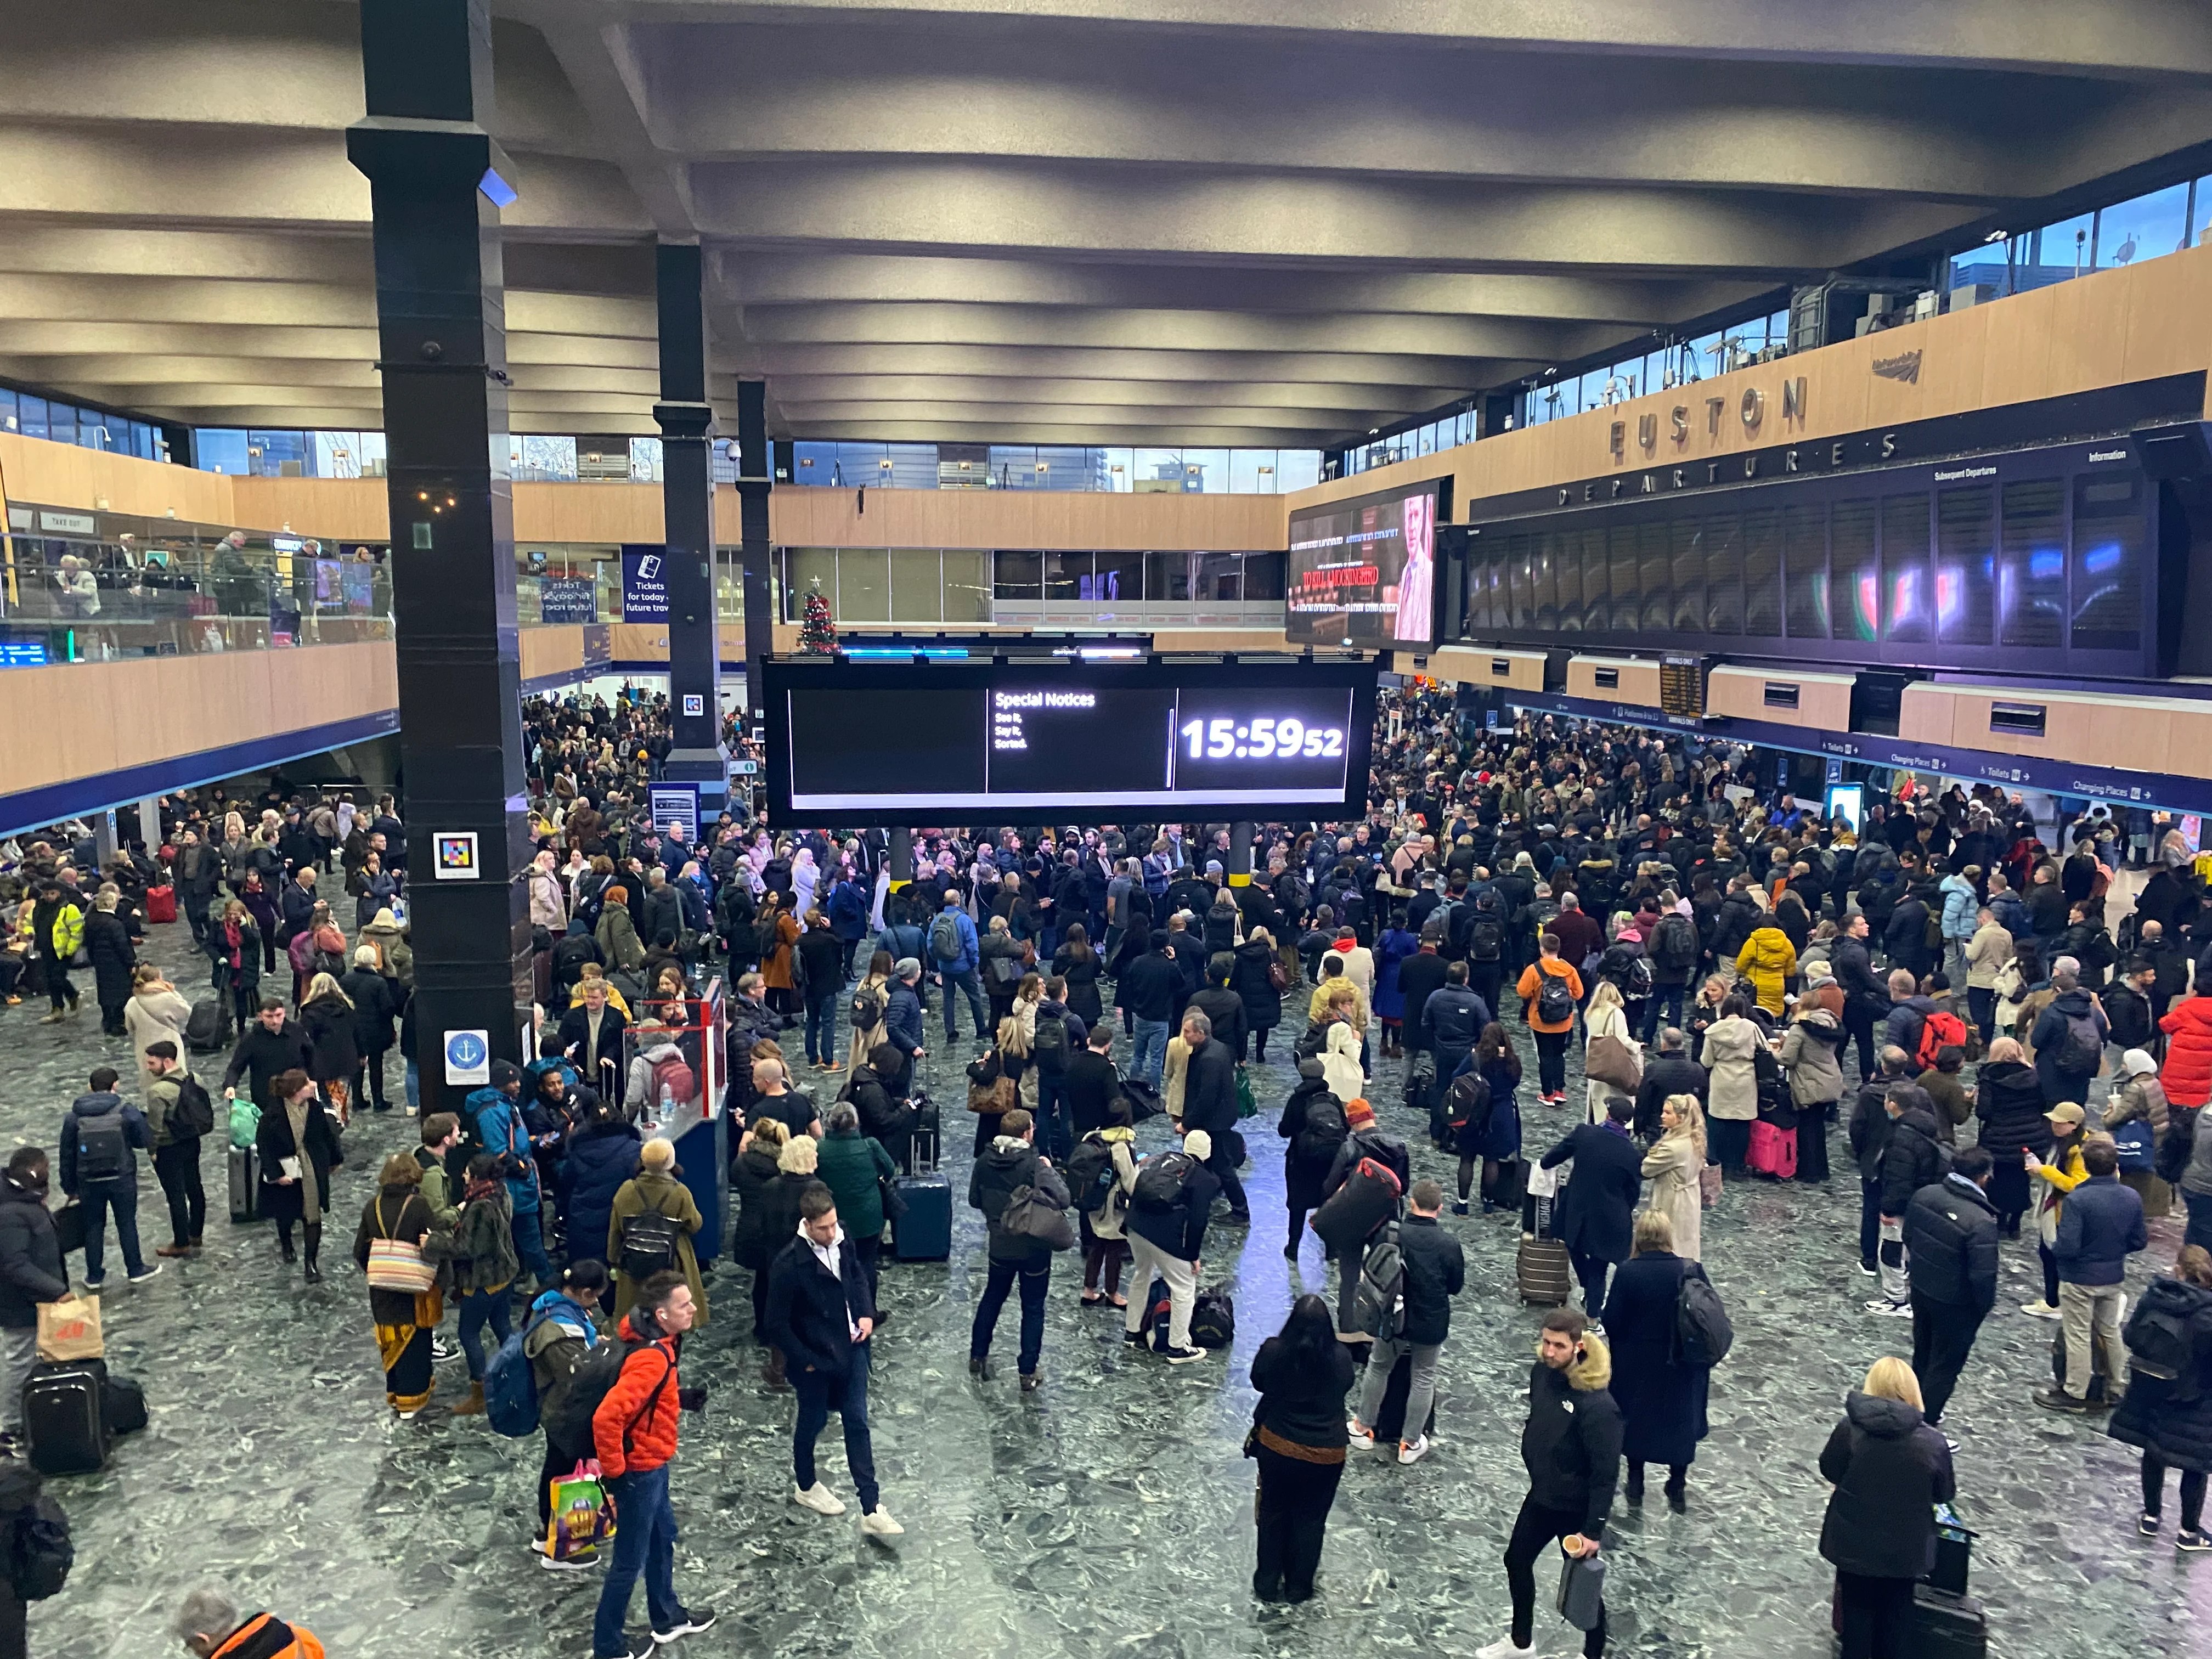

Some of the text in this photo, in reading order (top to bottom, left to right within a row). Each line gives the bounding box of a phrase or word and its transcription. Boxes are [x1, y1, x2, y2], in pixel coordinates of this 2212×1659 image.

[1610, 377, 1806, 454] EUSTON
[2089, 450, 2126, 462] Information
[1559, 434, 1895, 505] DEPARTURES
[1934, 467, 1996, 480] Subsequent Departures
[641, 593, 665, 602] today
[626, 603, 651, 612] future
[995, 692, 1096, 709] Special Notices
[995, 726, 1011, 737] Say
[1827, 743, 1844, 752] Toilets
[1891, 754, 1930, 766] Changing Places
[1988, 767, 2010, 778] Toilets
[2073, 781, 2128, 797] Changing Places
